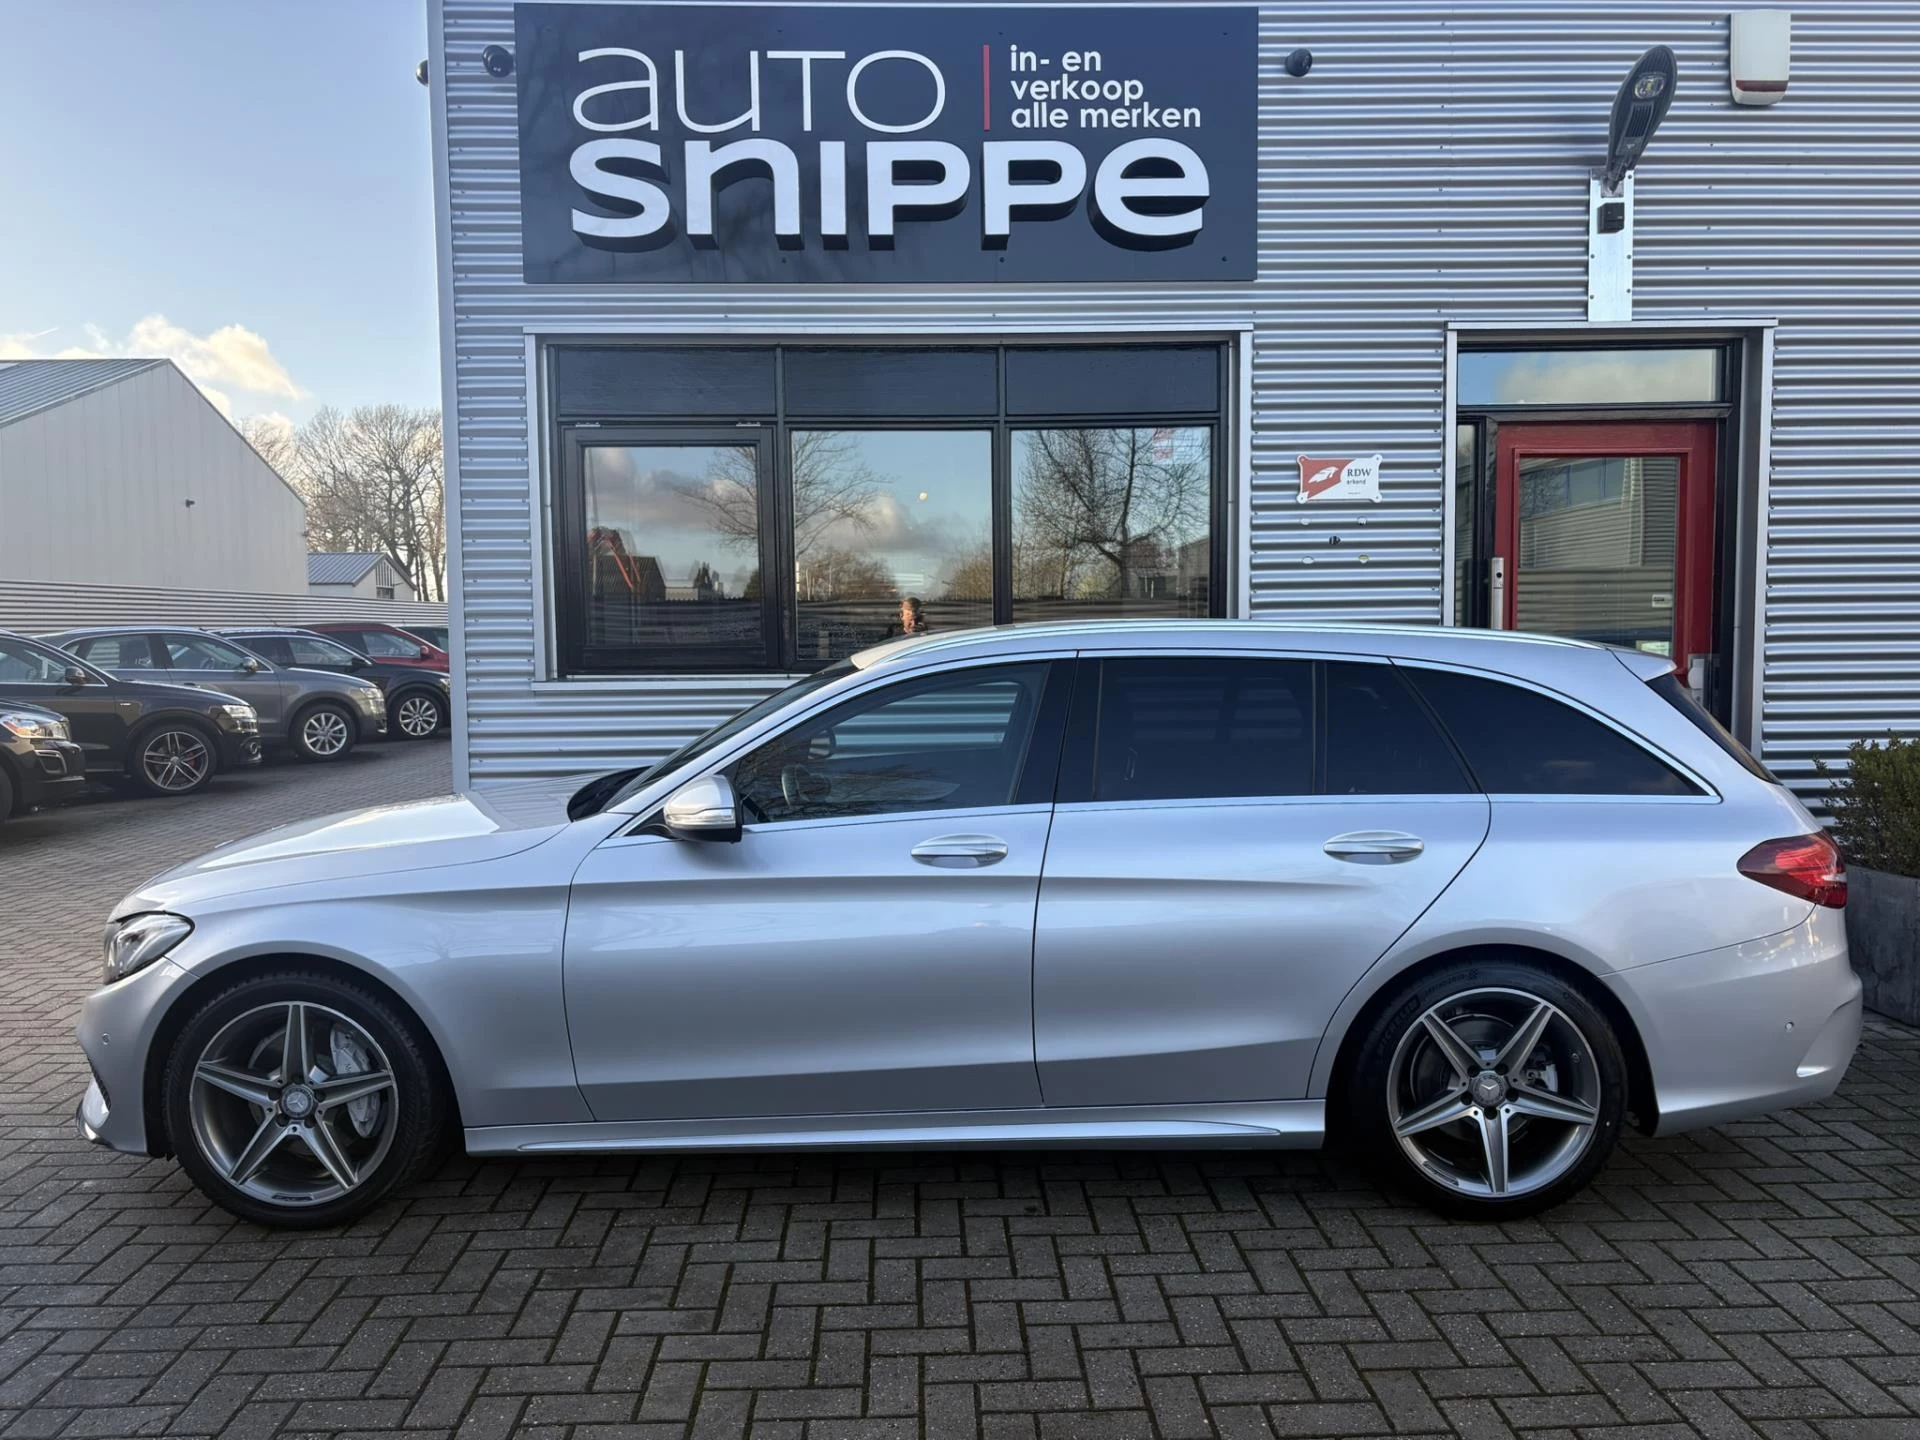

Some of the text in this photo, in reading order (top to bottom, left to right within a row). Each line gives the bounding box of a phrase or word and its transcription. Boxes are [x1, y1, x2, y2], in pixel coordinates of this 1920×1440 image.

[1009, 44, 1102, 73] in- en
[1010, 73, 1145, 107] verkoop
[1010, 101, 1202, 129] alle merken
[1347, 468, 1372, 477] RDW
